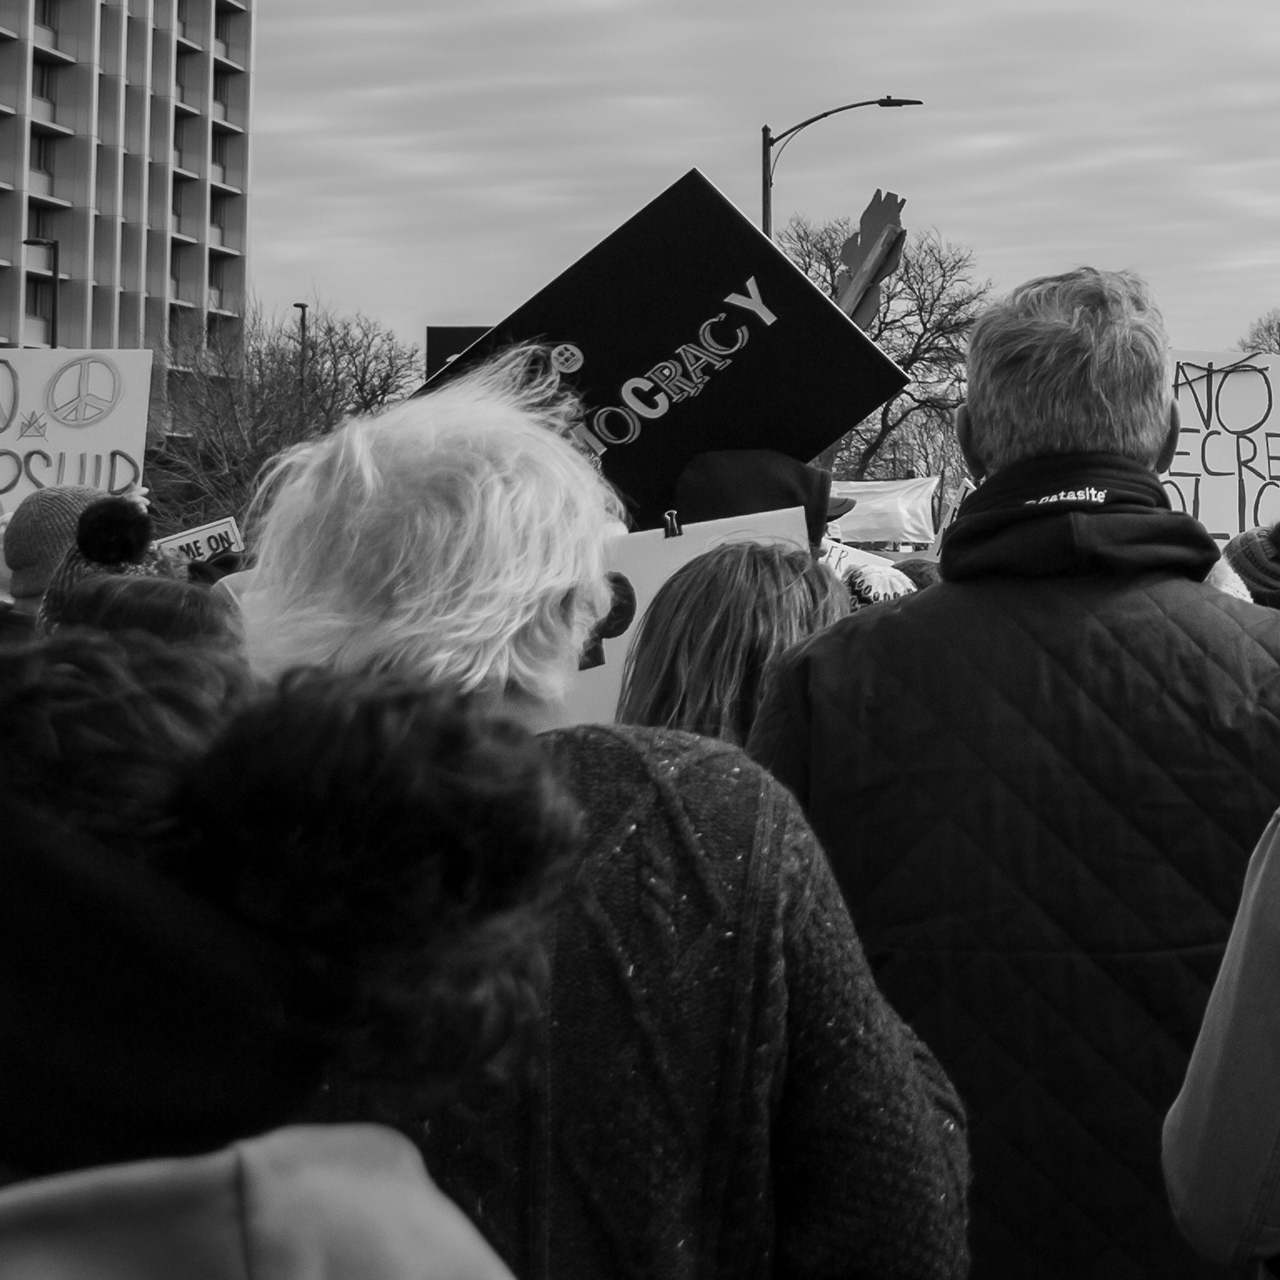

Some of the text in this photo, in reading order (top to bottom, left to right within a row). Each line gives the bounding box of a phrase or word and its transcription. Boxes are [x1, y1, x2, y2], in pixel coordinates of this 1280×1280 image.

[570, 275, 778, 456] OCRACY
[1174, 361, 1273, 436] NO
[207, 530, 232, 552] ON
